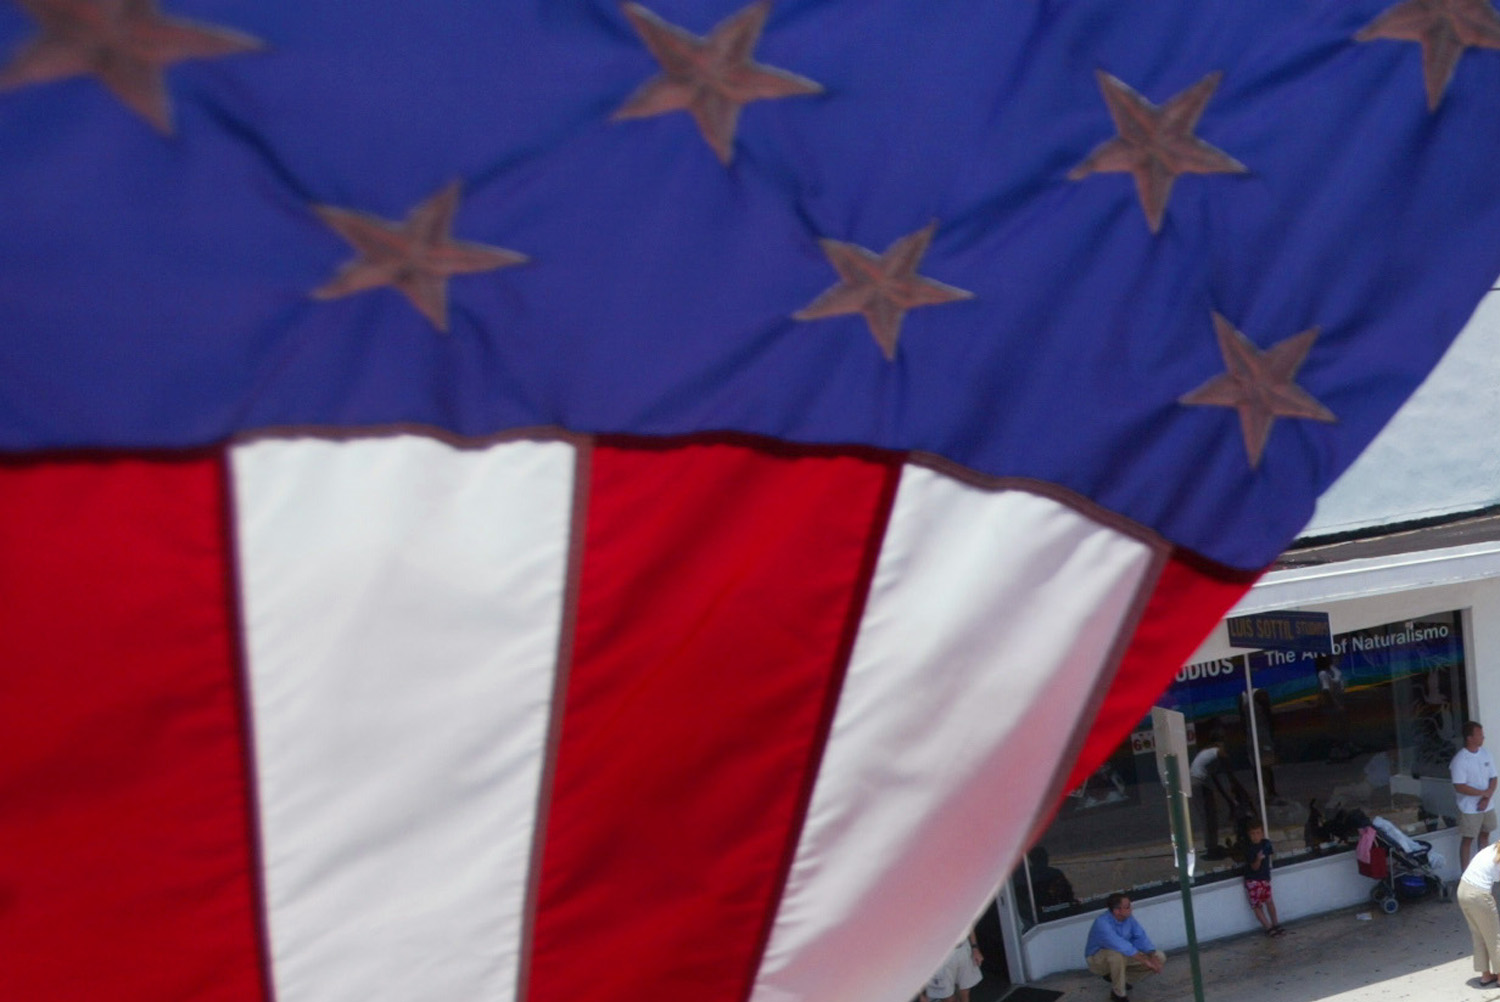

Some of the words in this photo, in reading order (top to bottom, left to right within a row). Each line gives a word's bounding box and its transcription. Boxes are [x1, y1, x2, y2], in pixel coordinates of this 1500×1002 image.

[1264, 650, 1296, 667] The
[1332, 638, 1347, 655] of
[1352, 625, 1449, 651] Naturalismo
[1175, 658, 1234, 682] UDIOS
